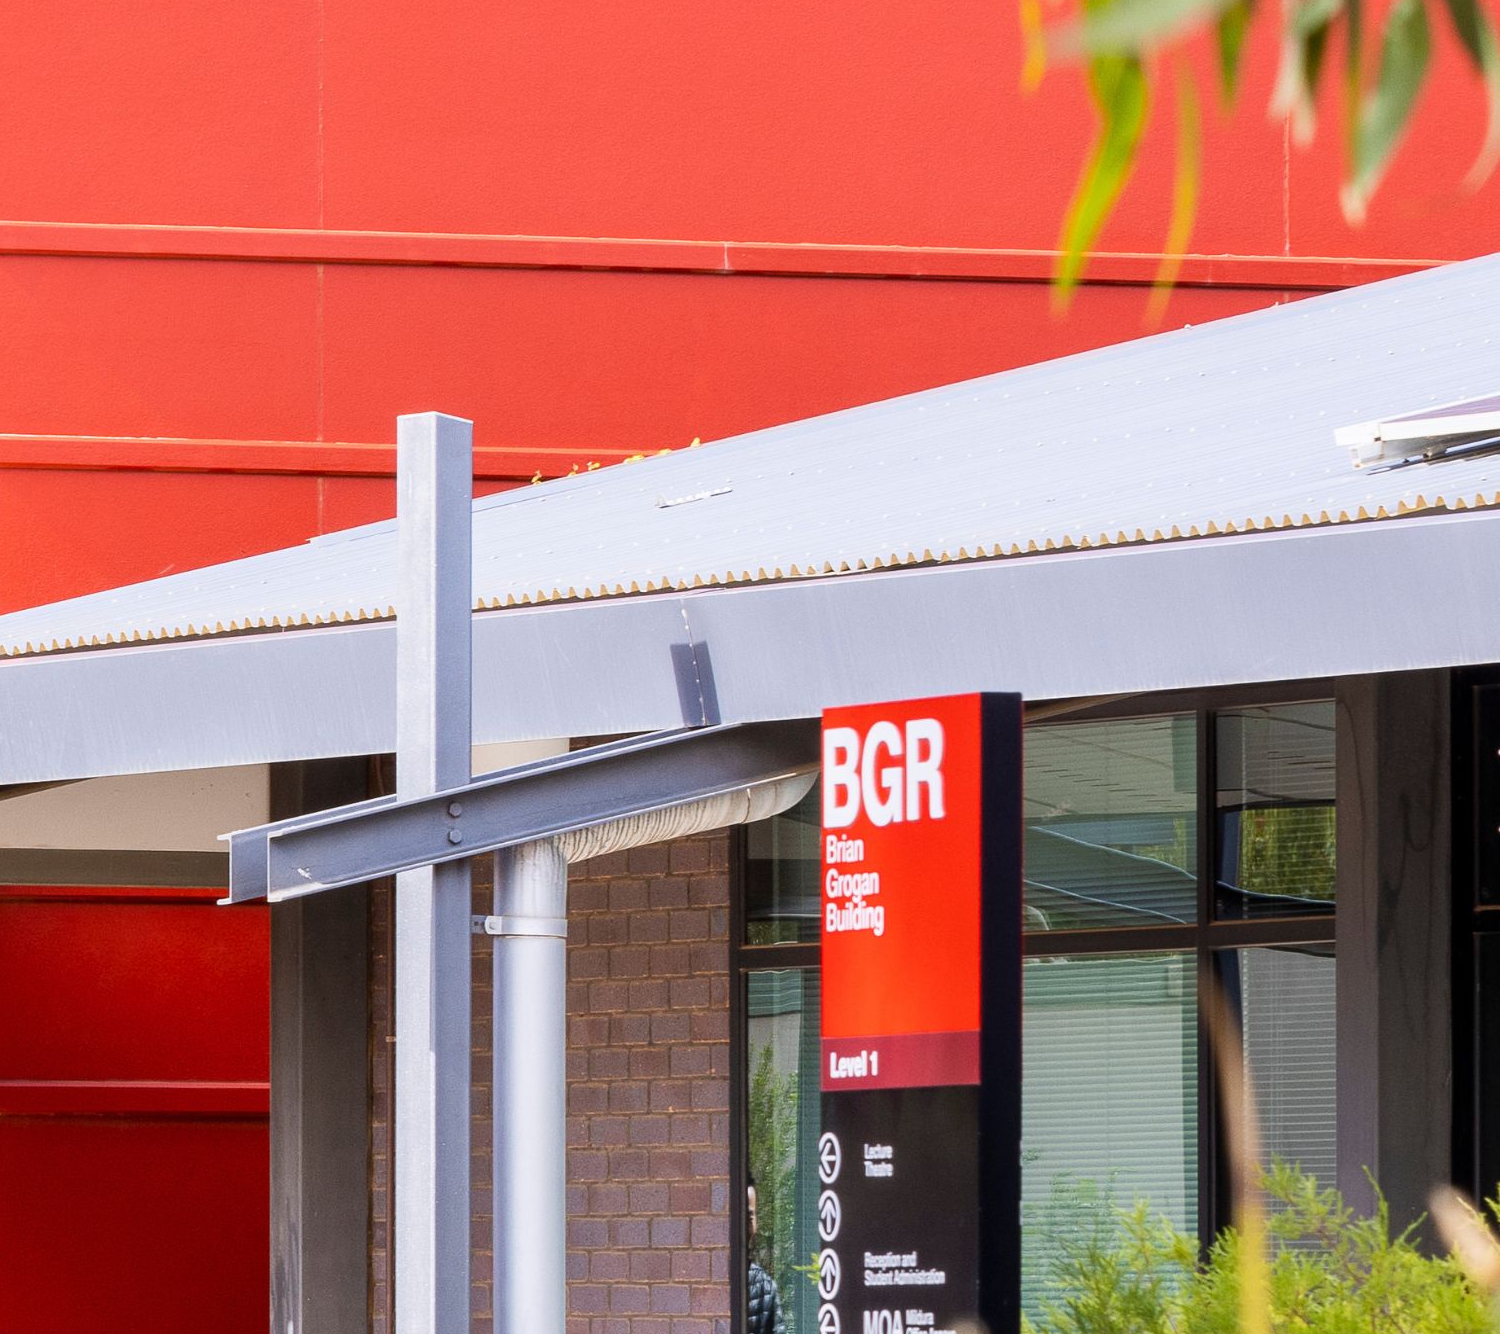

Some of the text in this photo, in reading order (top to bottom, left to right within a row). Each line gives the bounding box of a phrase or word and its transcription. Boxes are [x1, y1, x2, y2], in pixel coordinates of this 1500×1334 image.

[823, 717, 946, 829] BGR
[825, 834, 864, 864] Brian
[825, 868, 880, 903] Grogan
[825, 900, 885, 937] Building
[829, 1049, 879, 1079] Level 1
[863, 1143, 894, 1160] Lecture
[863, 1160, 894, 1178] Theatre
[863, 1251, 917, 1270] Reception and
[863, 1268, 946, 1286] Student Administration
[905, 1308, 934, 1326] Mildura
